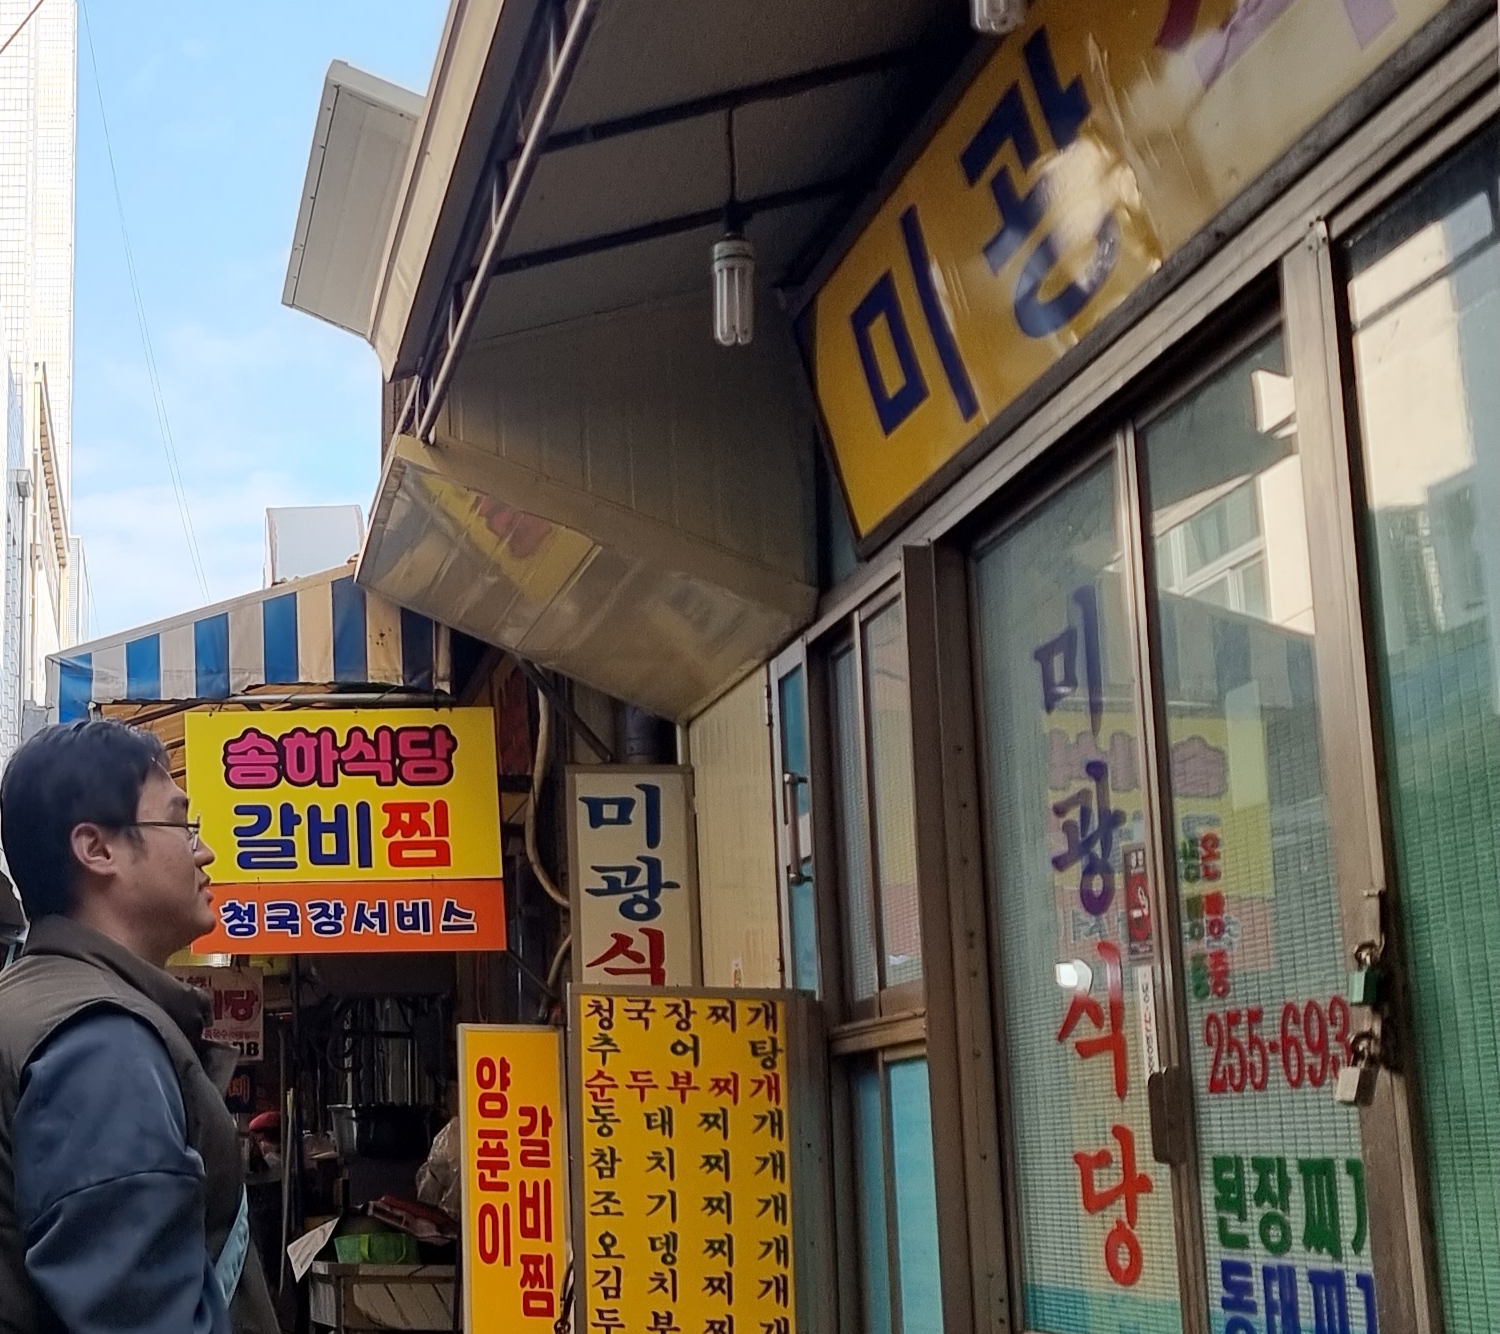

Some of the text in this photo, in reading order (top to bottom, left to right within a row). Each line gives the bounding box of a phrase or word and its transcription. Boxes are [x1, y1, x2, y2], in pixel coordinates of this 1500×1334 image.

[222, 725, 459, 789] 송하식당
[233, 800, 452, 870] 갈비찜
[219, 898, 477, 938] 청국장서비스
[585, 997, 779, 1034] 청국장찌개
[587, 1033, 784, 1070] 추어탕
[1204, 995, 1352, 1095] 255-693
[585, 1069, 781, 1106] 순두부찌개
[587, 1104, 784, 1142] 동태찌개
[475, 1056, 512, 1267] 양푼이
[588, 1145, 786, 1184] 참치찌개
[518, 1104, 555, 1319] 갈비찜
[589, 1189, 788, 1226] 조기찌개
[591, 1265, 790, 1309] 김치찌개
